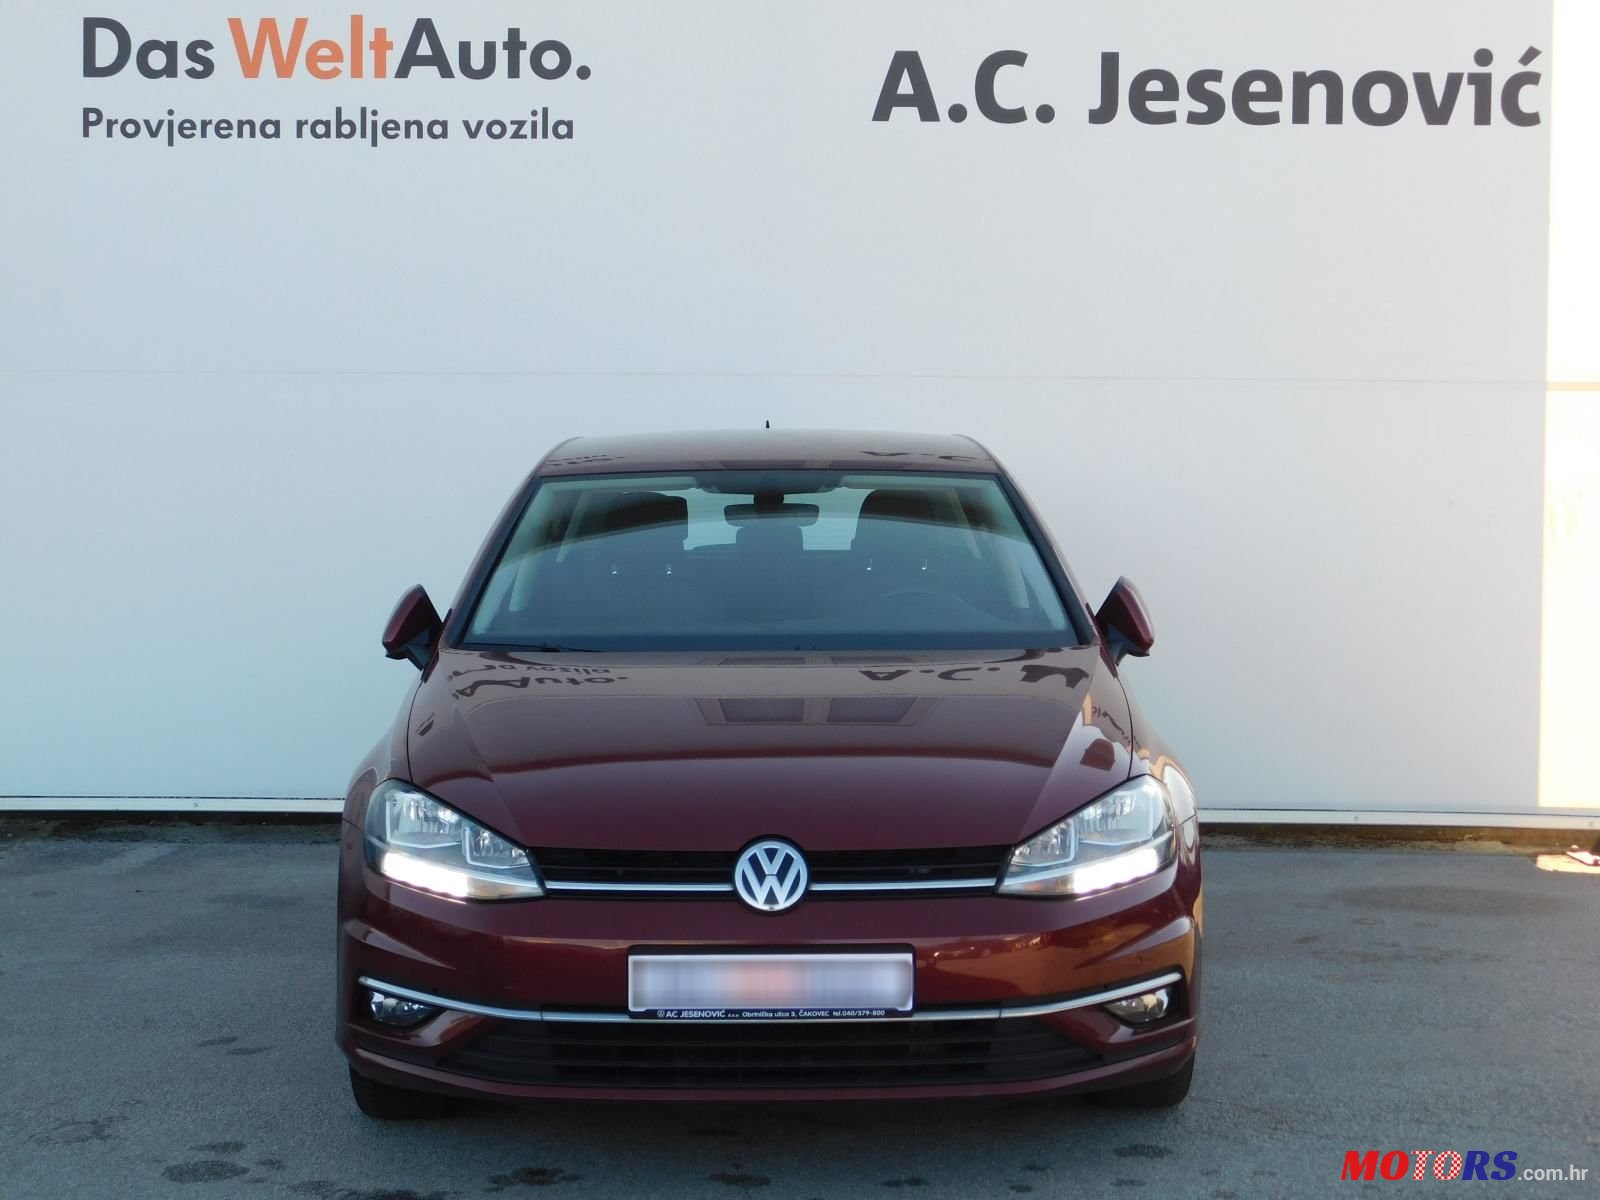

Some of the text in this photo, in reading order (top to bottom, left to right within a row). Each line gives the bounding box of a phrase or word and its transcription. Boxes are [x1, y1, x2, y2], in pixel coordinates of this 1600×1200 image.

[82, 14, 592, 81] Das WeltAuto.
[872, 46, 1542, 127] A.C. Jesenović
[82, 106, 574, 148] Provjerena rabljena vozila
[680, 1010, 726, 1018] JESENOVIĆ
